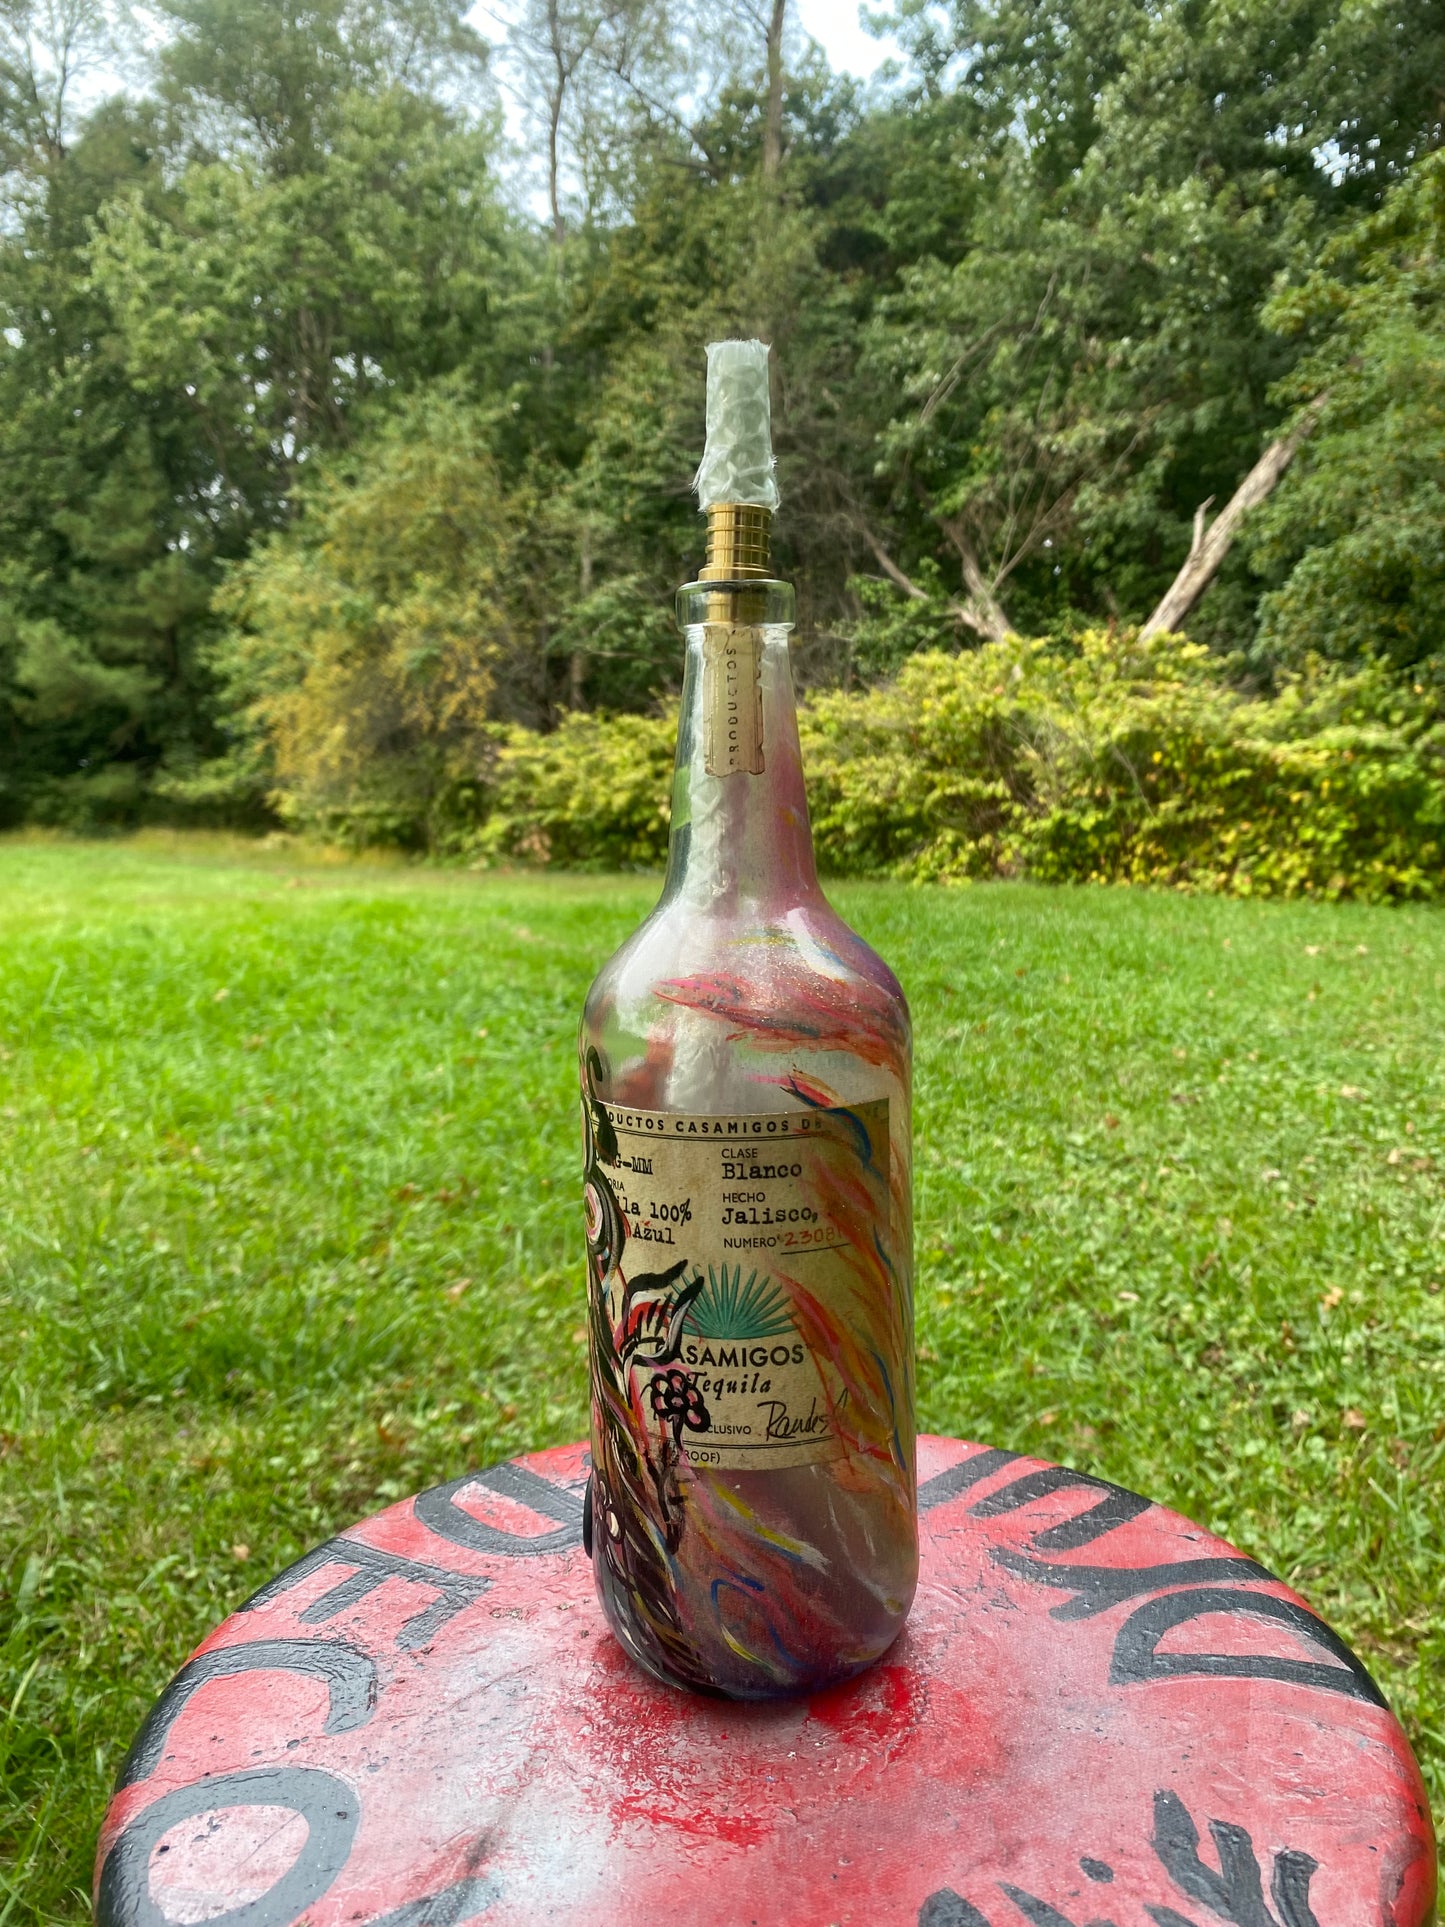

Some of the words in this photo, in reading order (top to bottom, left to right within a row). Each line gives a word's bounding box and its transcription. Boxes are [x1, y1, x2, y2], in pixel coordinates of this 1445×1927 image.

[675, 1119, 789, 1134] CASAMIGOS
[722, 1148, 758, 1159] CLASE
[721, 1162, 802, 1180] Blanco
[722, 1192, 766, 1203] HECHO
[650, 1198, 692, 1227] 100%
[721, 1207, 818, 1225] Jalisco,
[632, 1222, 676, 1245] Azul
[687, 1370, 772, 1400] Tequila
